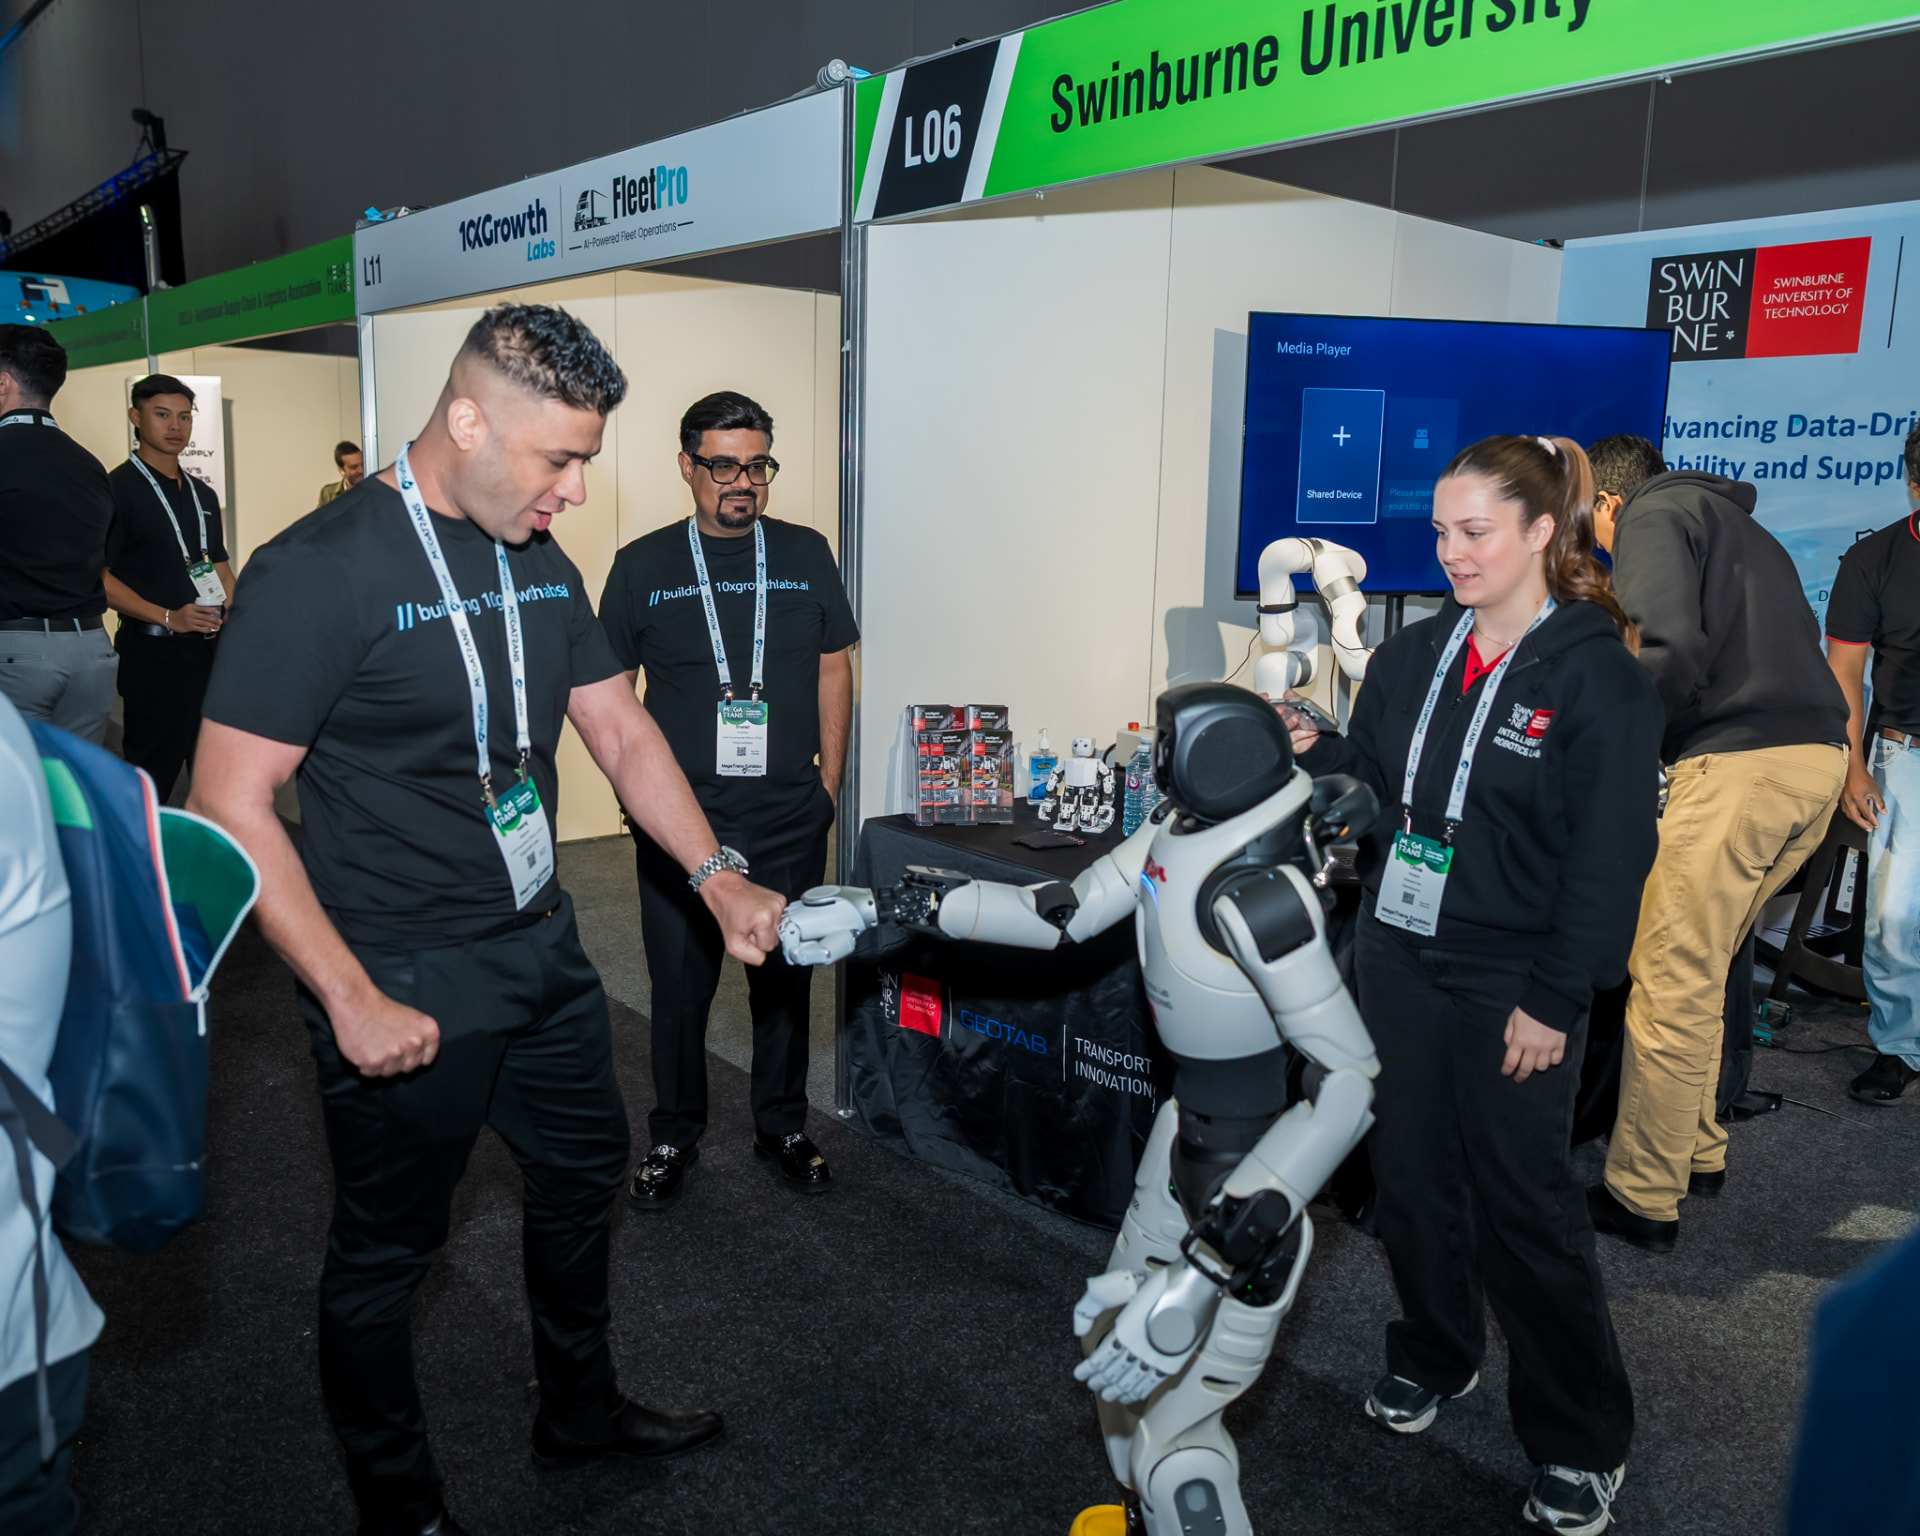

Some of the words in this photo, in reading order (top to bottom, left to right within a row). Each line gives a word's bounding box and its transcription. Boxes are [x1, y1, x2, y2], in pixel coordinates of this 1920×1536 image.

[1049, 33, 1280, 135] Swinburne
[903, 104, 962, 169] L06
[612, 165, 688, 219] FleetPro
[527, 238, 555, 262] Labs
[583, 231, 620, 250] AI-Powered
[620, 228, 637, 243] Fleet
[638, 221, 677, 241] Operations
[363, 253, 382, 286] L11
[1773, 272, 1845, 289] SWINBURNE
[1667, 291, 1730, 323] BUR
[1762, 289, 1833, 305] UNIVERSITY
[1835, 287, 1853, 300] OF
[1764, 303, 1849, 320] TECHNOLOGY
[1277, 341, 1313, 355] Media
[1316, 342, 1352, 358] Player
[1663, 413, 1778, 443] dvancing
[1786, 411, 1920, 438] Data-Dri
[1753, 453, 1809, 479] and
[1816, 453, 1906, 486] Suppl
[1306, 488, 1334, 500] Shared
[1336, 489, 1363, 500] Device
[1389, 487, 1414, 497] Please
[1415, 487, 1433, 497] inser
[663, 585, 702, 600] buildin
[715, 579, 809, 595] 10xgrothlabs.ai
[960, 1009, 1047, 1055] GEOTAB
[1074, 1037, 1153, 1075] TRANSPORT
[1075, 1060, 1152, 1099] INNOVATION
